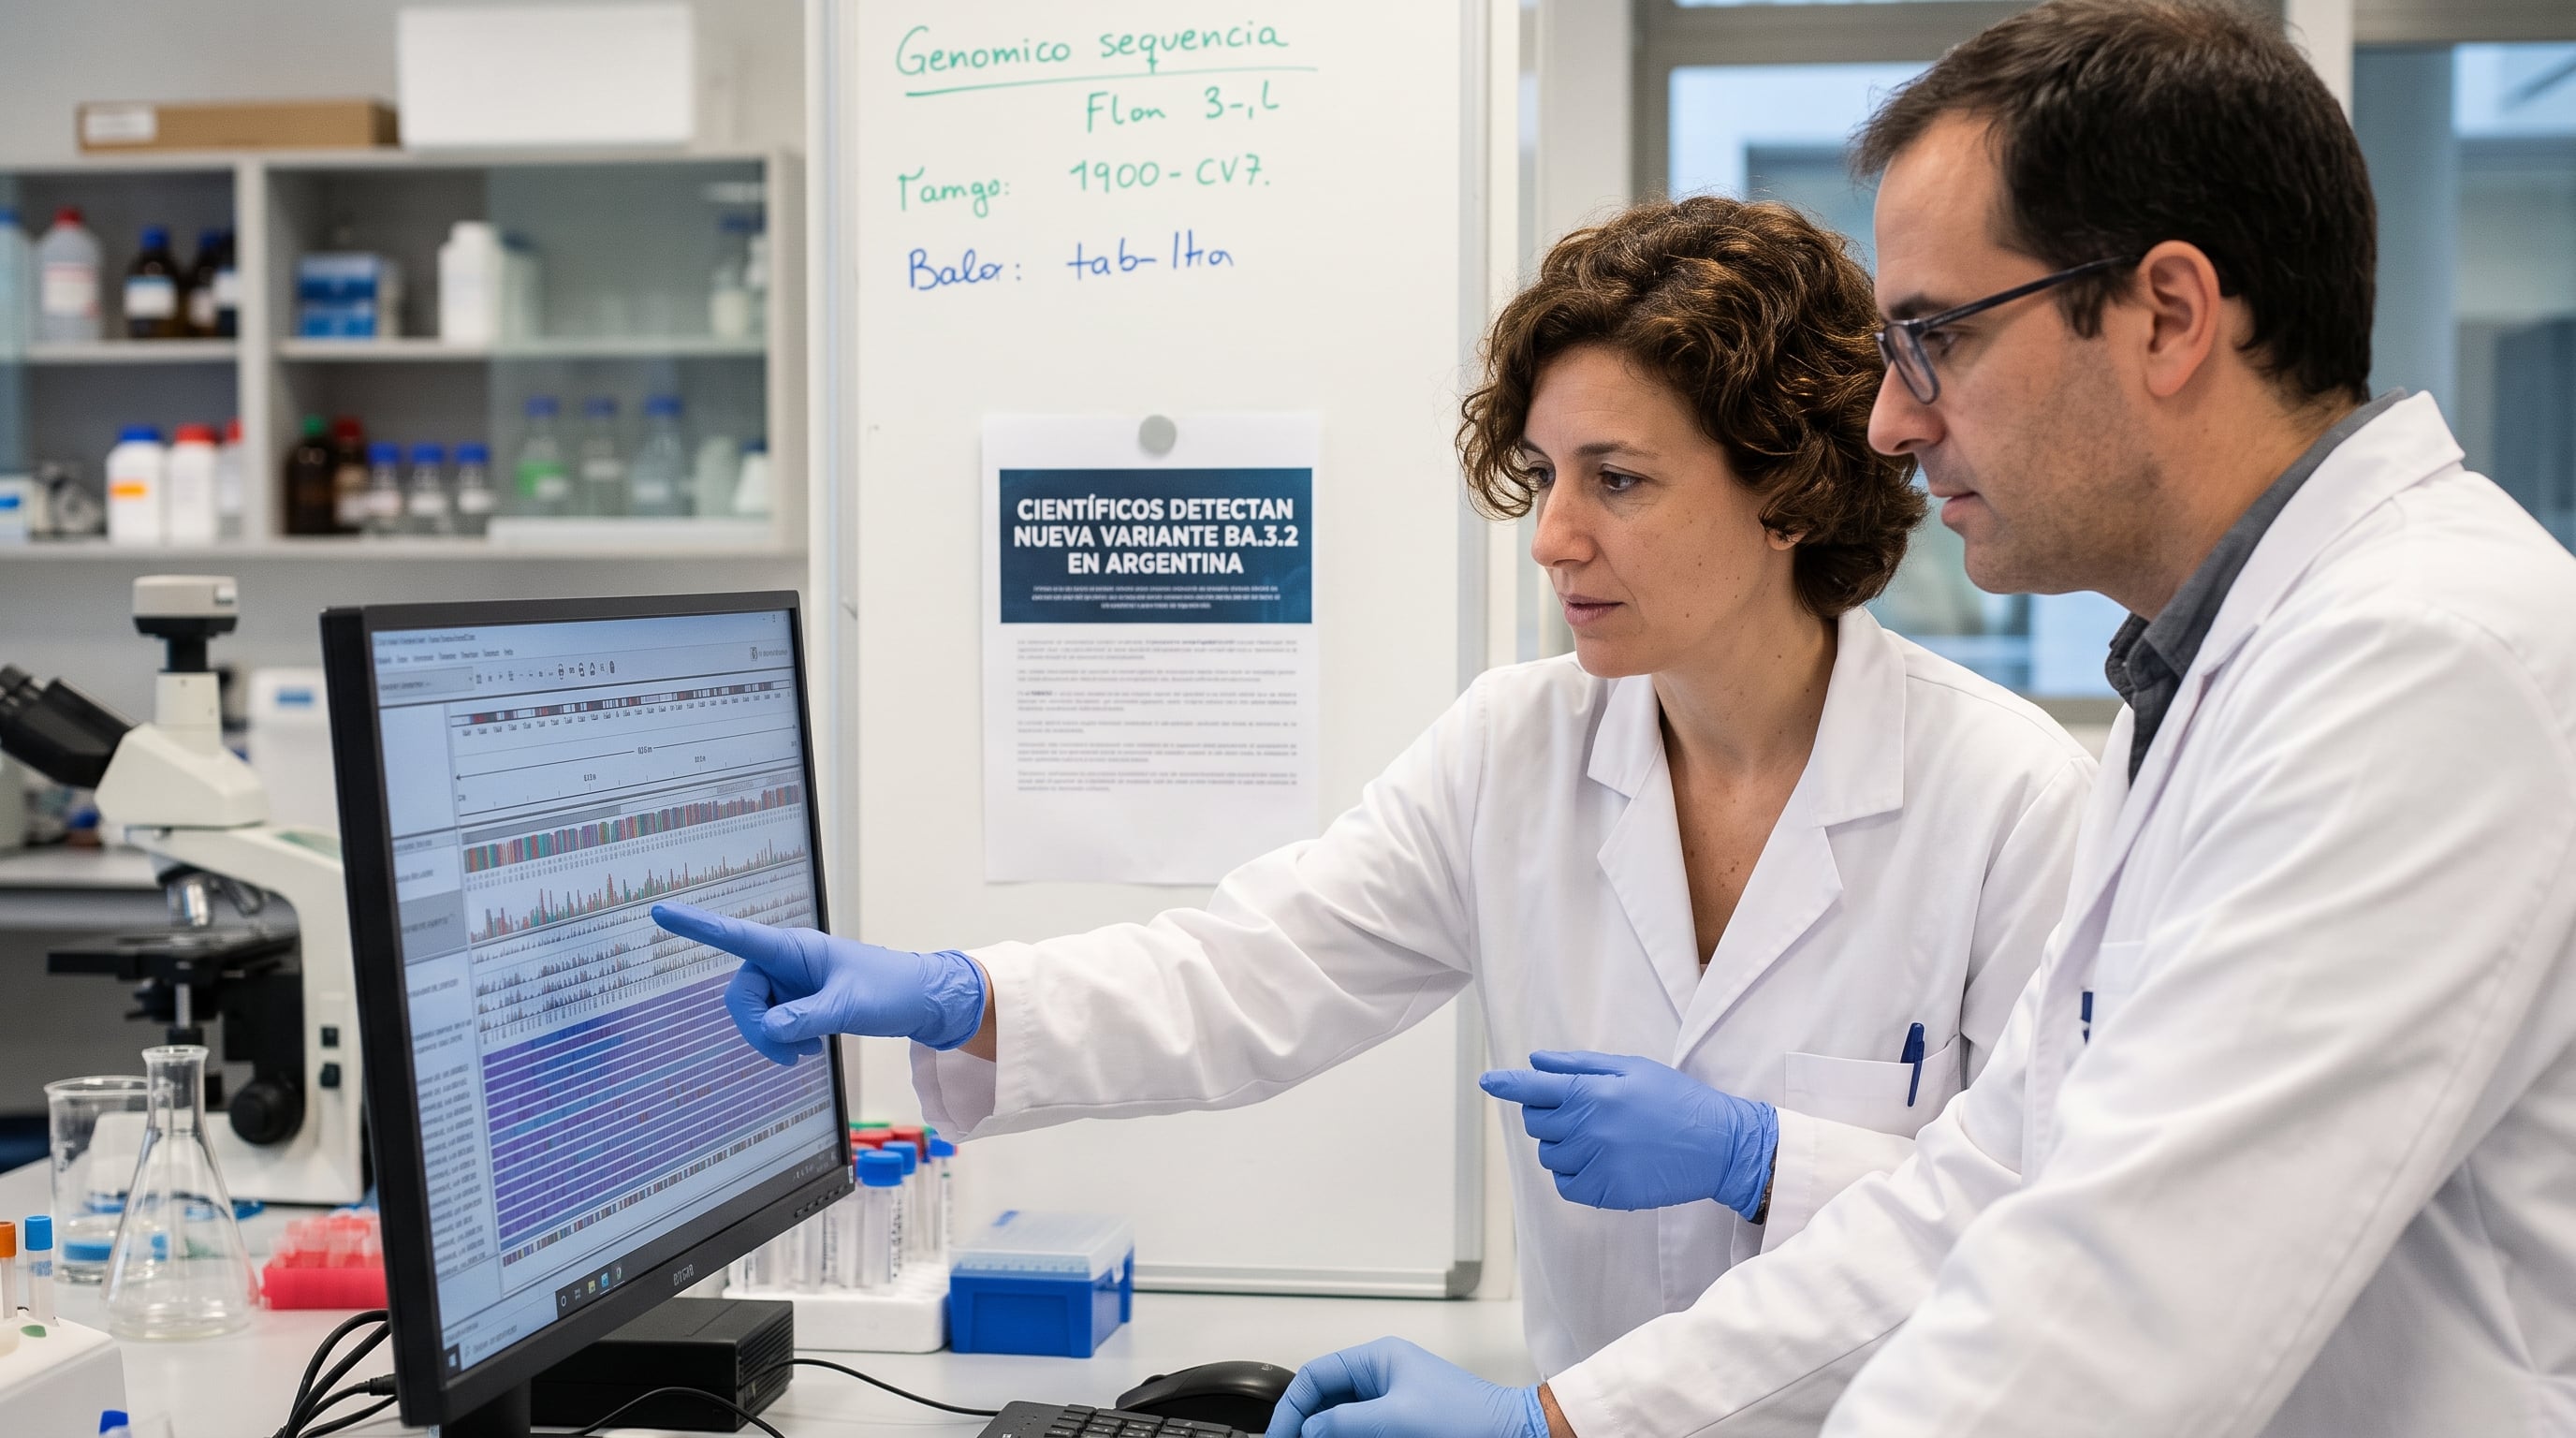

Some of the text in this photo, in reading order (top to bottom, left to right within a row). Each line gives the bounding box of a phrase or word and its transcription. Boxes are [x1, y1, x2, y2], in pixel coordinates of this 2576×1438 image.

[895, 21, 1291, 76] Genomico sequencia
[1017, 493, 1294, 521] CIENTÍFICOS DETECTAN
[1014, 525, 1299, 547] NUEVA VARIANTE BA.3.2
[1067, 552, 1244, 574] EN ARGENTINA
